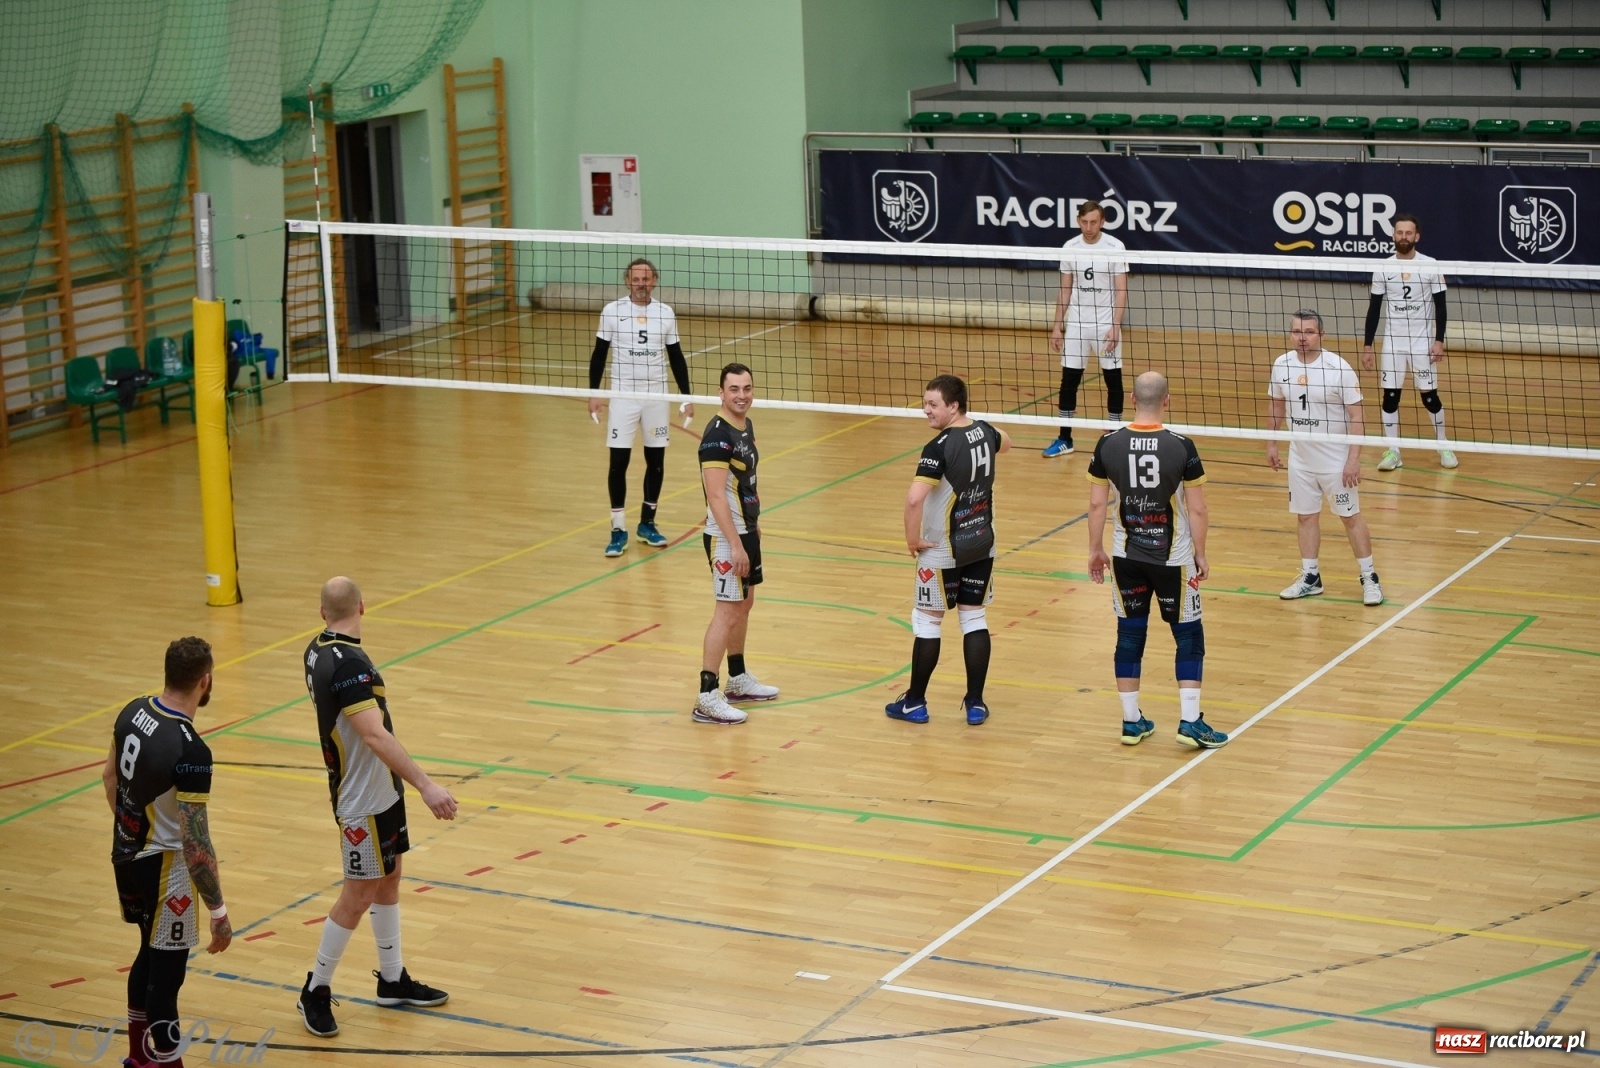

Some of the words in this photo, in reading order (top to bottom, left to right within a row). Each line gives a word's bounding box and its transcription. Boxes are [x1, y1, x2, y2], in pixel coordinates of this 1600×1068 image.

[1322, 238, 1397, 254] RACIBÓRZ
[1083, 267, 1094, 281] 6
[1402, 285, 1412, 300] 2
[637, 330, 648, 344] 5
[1298, 393, 1307, 411] 1
[611, 428, 618, 439] 5
[965, 426, 985, 444] ENTER
[1129, 437, 1159, 451] ENTER
[970, 441, 991, 483] 14
[1128, 453, 1161, 489] 13
[718, 578, 727, 593] 7
[918, 586, 931, 602] 14
[1191, 593, 1201, 611] 13
[131, 707, 160, 738] ENTER
[119, 732, 142, 782] 8
[349, 850, 362, 871] 2
[171, 921, 184, 942] 8
